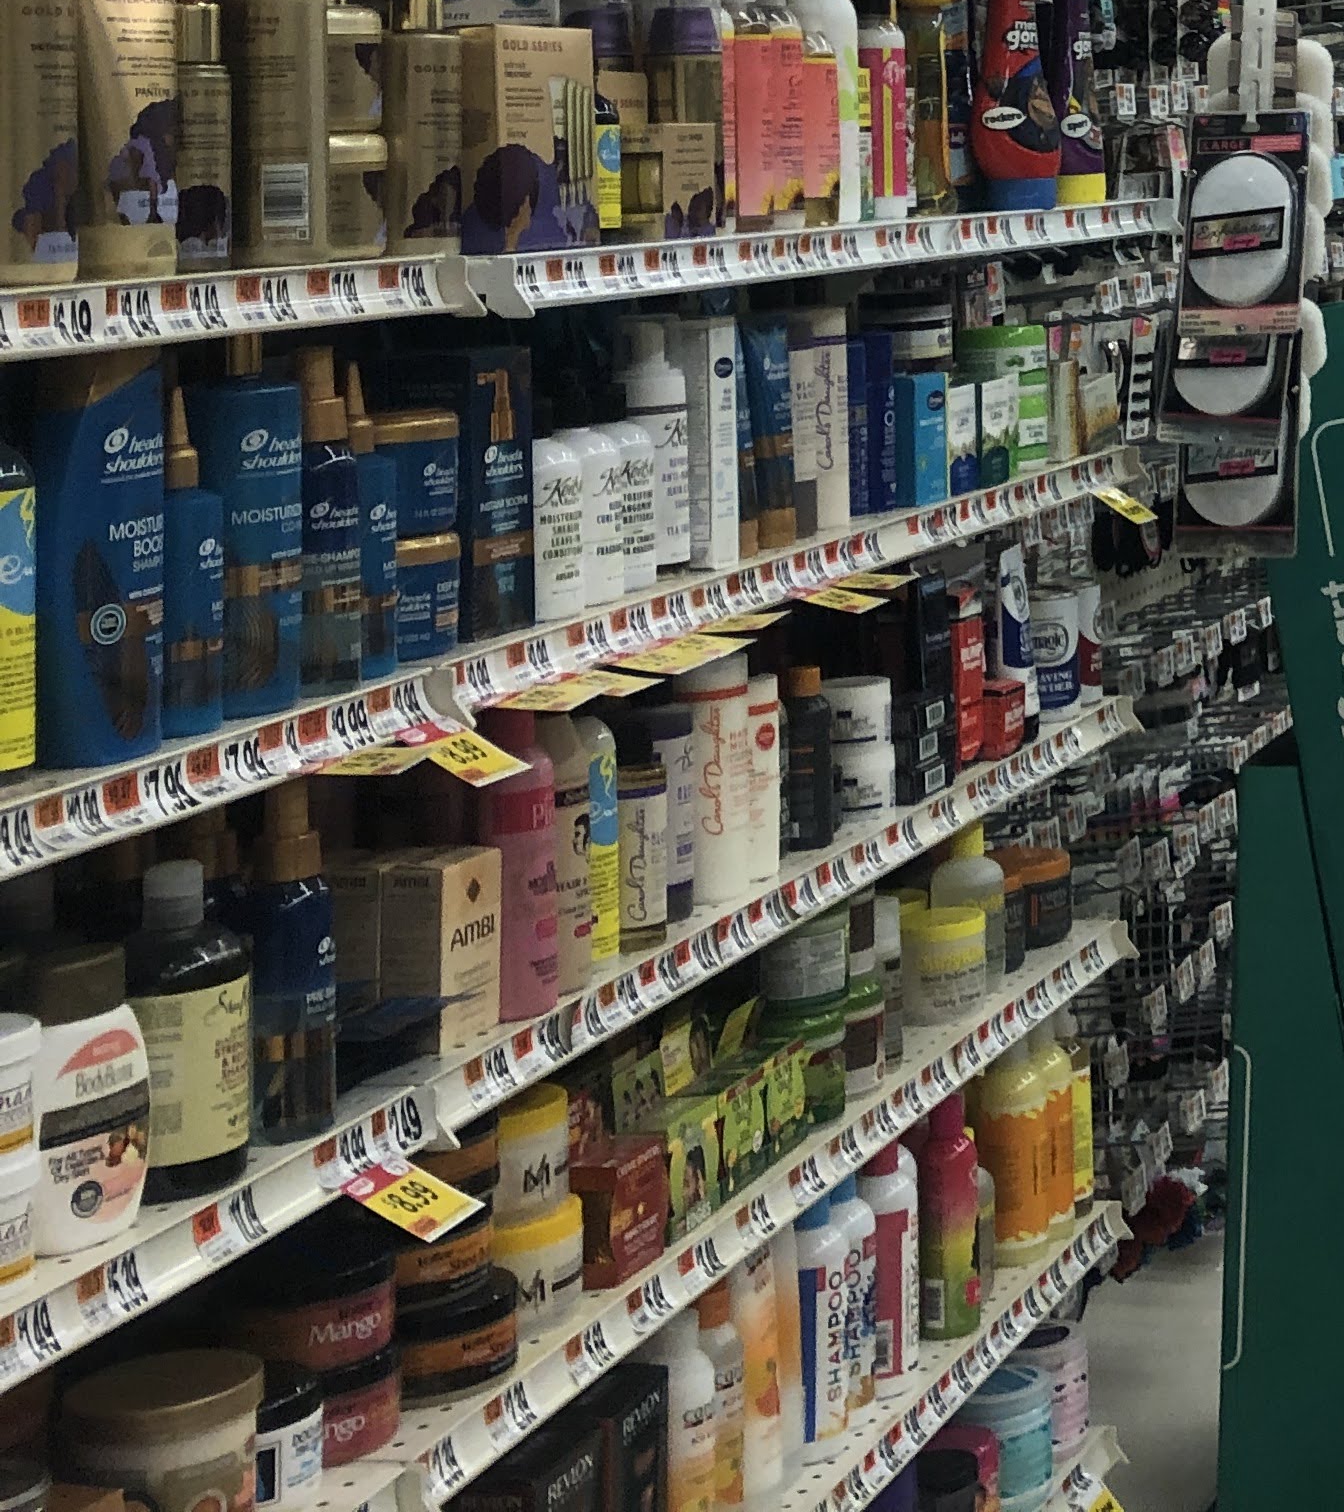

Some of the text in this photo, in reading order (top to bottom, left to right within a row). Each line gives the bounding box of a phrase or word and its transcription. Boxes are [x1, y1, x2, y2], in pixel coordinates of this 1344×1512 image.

[502, 39, 529, 51] GOLD
[450, 913, 495, 952] AMBI
[381, 1178, 439, 1215] $8.99
[309, 1312, 382, 1347] Mango
[847, 1248, 862, 1378] SHAMPOO
[828, 1270, 843, 1402] SHAMPOO
[325, 1414, 366, 1442] ngo
[548, 1453, 594, 1505] REVLON
